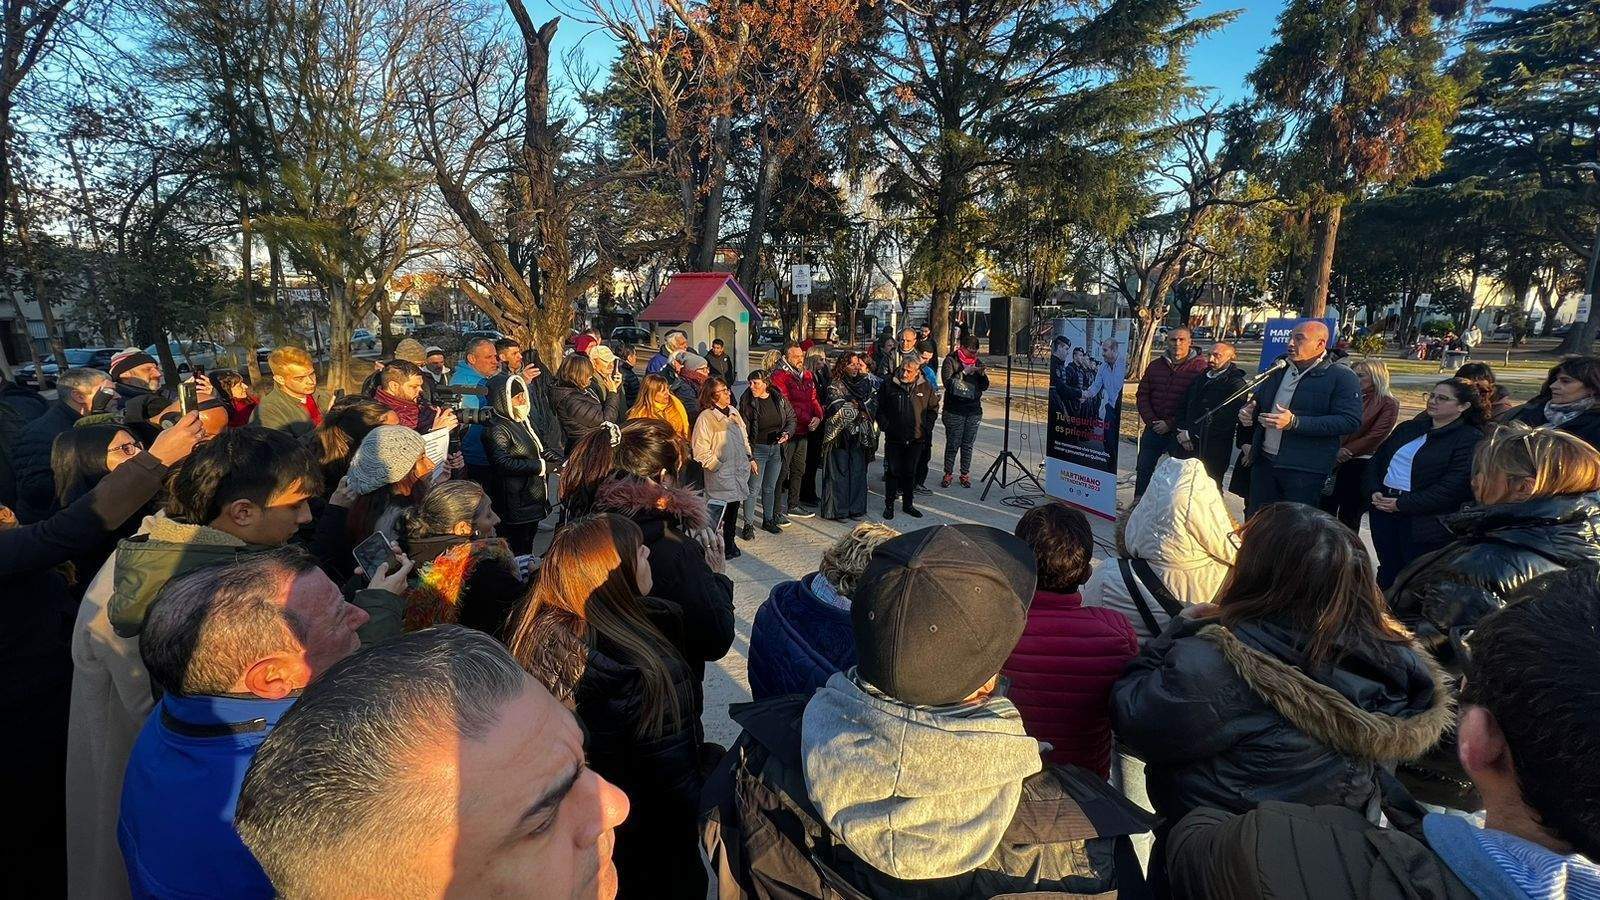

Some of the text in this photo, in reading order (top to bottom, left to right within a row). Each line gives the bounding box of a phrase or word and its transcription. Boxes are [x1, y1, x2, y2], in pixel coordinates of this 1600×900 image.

[1055, 411, 1065, 421] Tu
[1055, 425, 1065, 433] es
[1060, 469, 1100, 486] MARTINIANO
